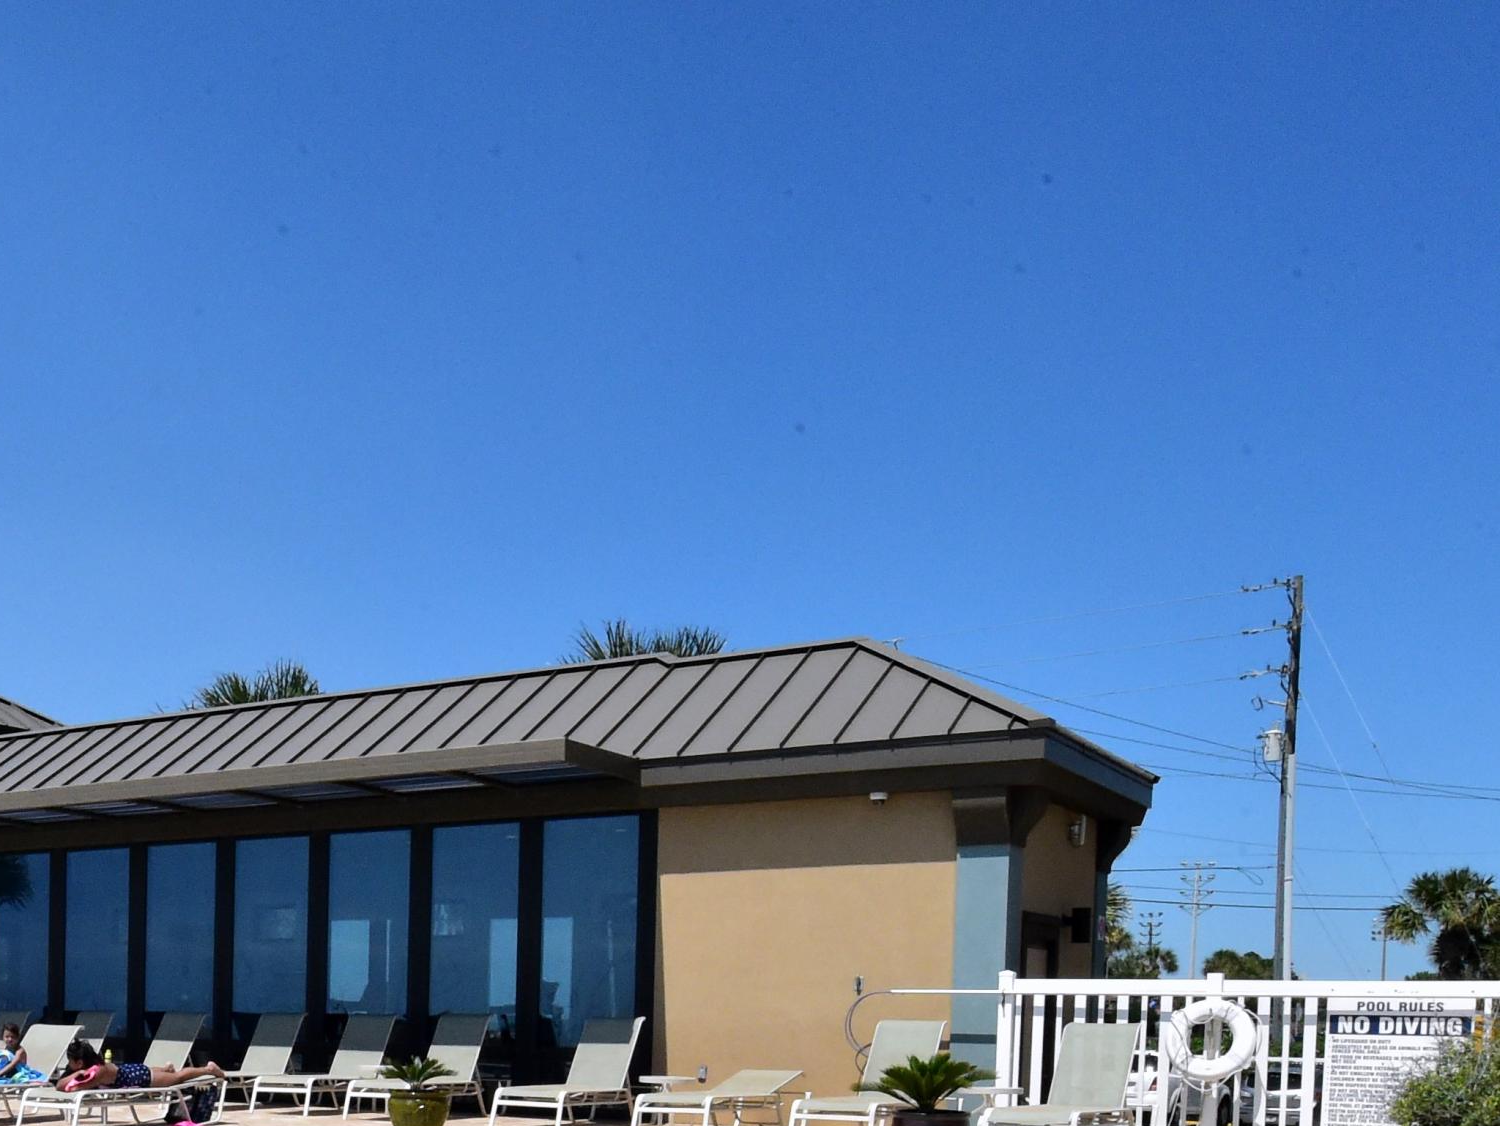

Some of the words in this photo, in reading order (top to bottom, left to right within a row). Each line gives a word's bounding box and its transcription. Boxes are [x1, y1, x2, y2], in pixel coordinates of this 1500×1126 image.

[1357, 1002, 1394, 1012] POOL
[1400, 1002, 1444, 1012] RULES
[1338, 1016, 1370, 1034] NO
[1378, 1017, 1463, 1035] DIVING
